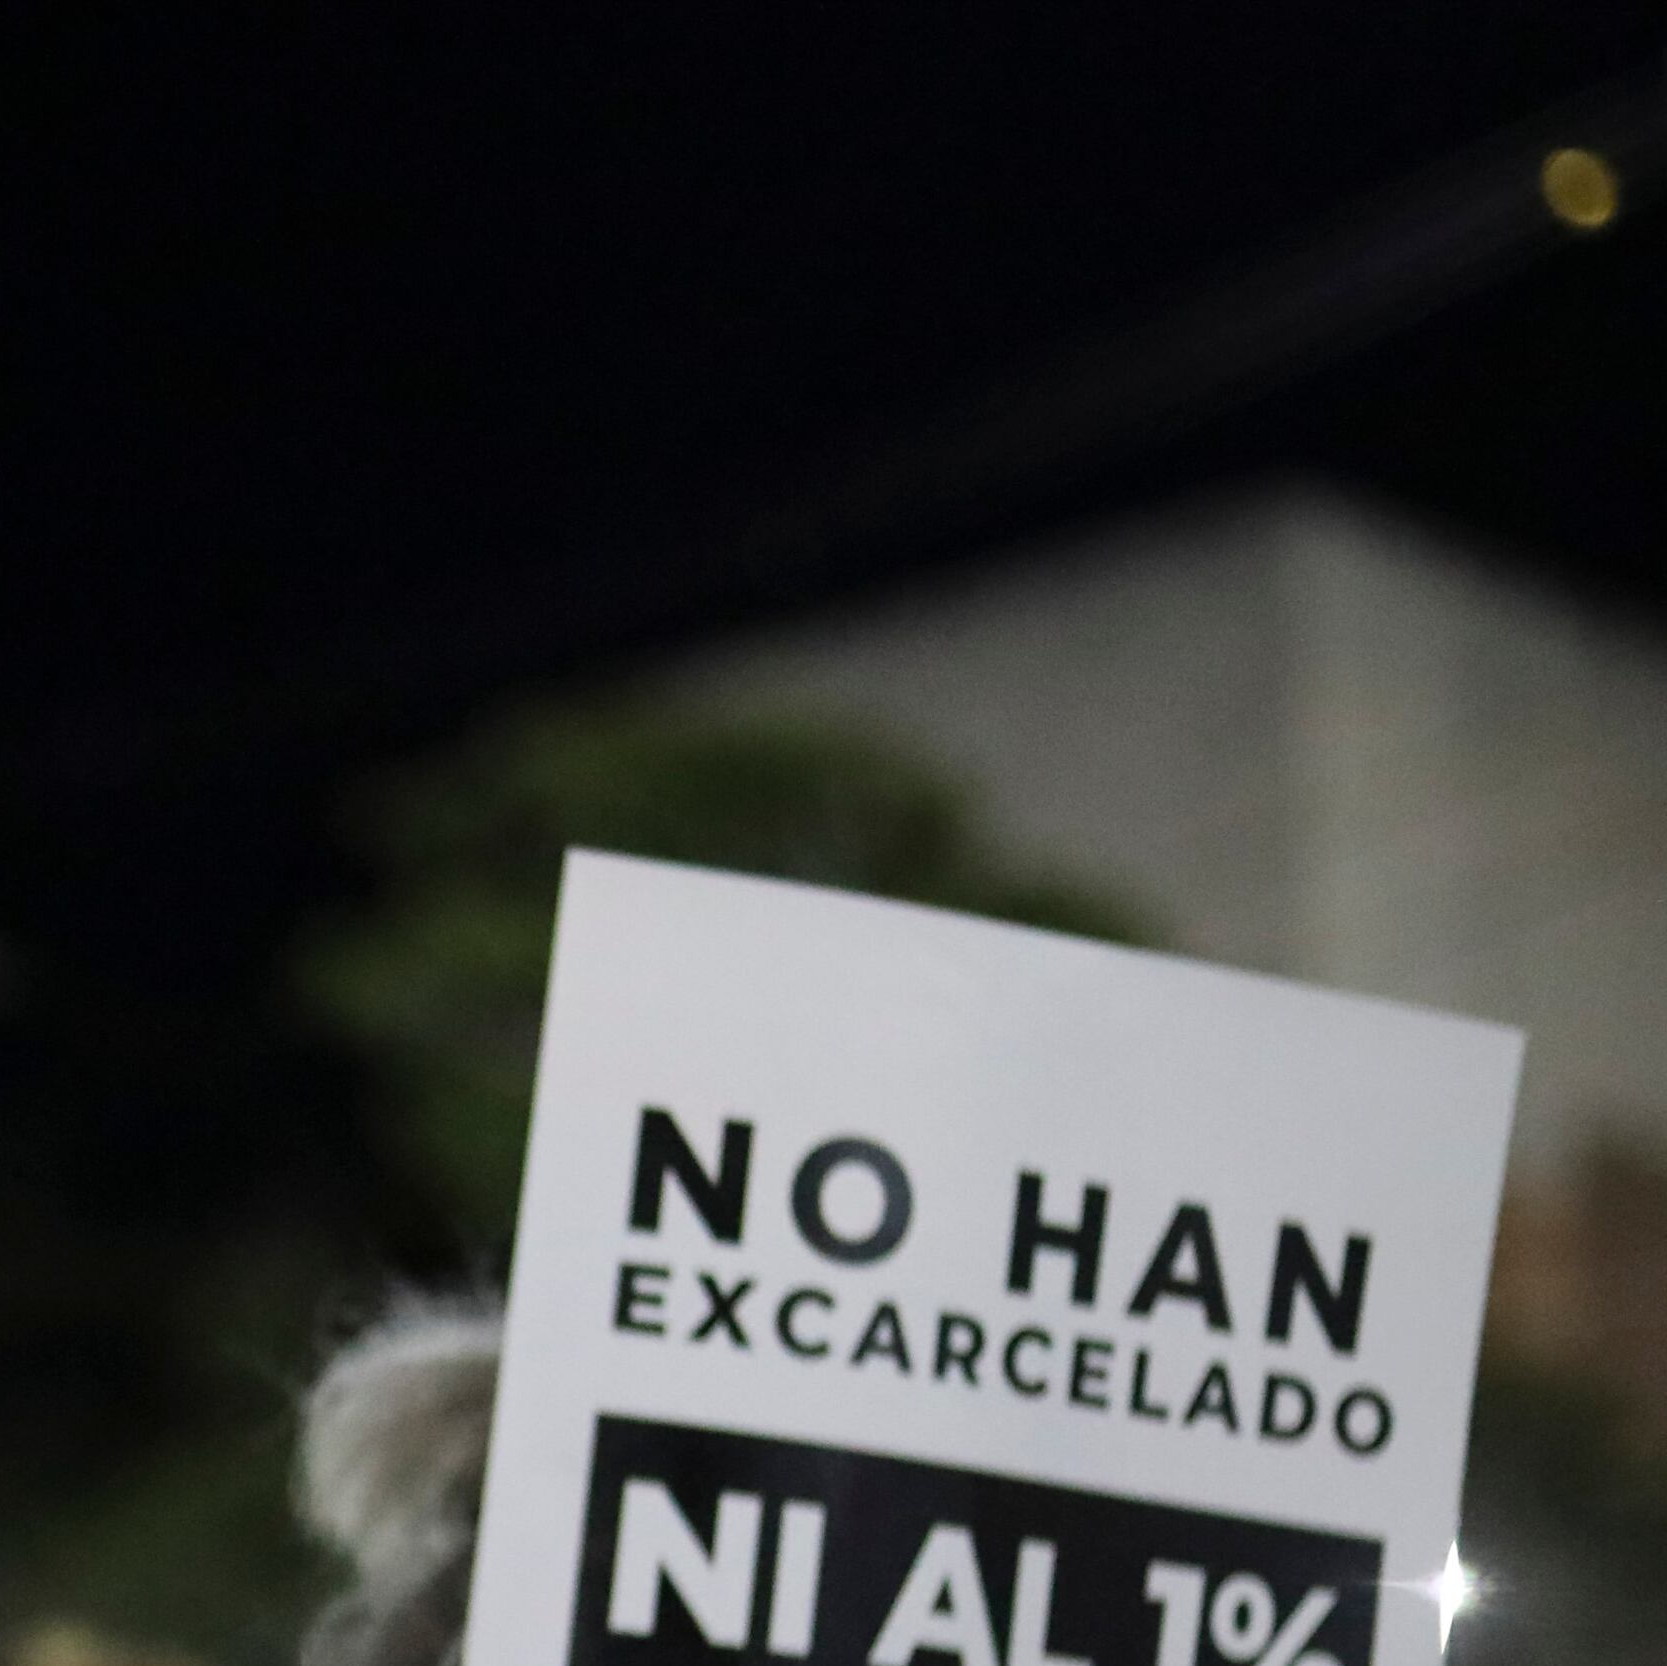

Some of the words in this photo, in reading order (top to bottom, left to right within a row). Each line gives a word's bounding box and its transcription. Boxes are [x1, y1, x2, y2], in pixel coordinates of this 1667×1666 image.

[627, 1105, 914, 1266] NO
[1004, 1166, 1374, 1355] HAN
[610, 1261, 1395, 1460] EXCARCELADO
[605, 1476, 827, 1662] NI
